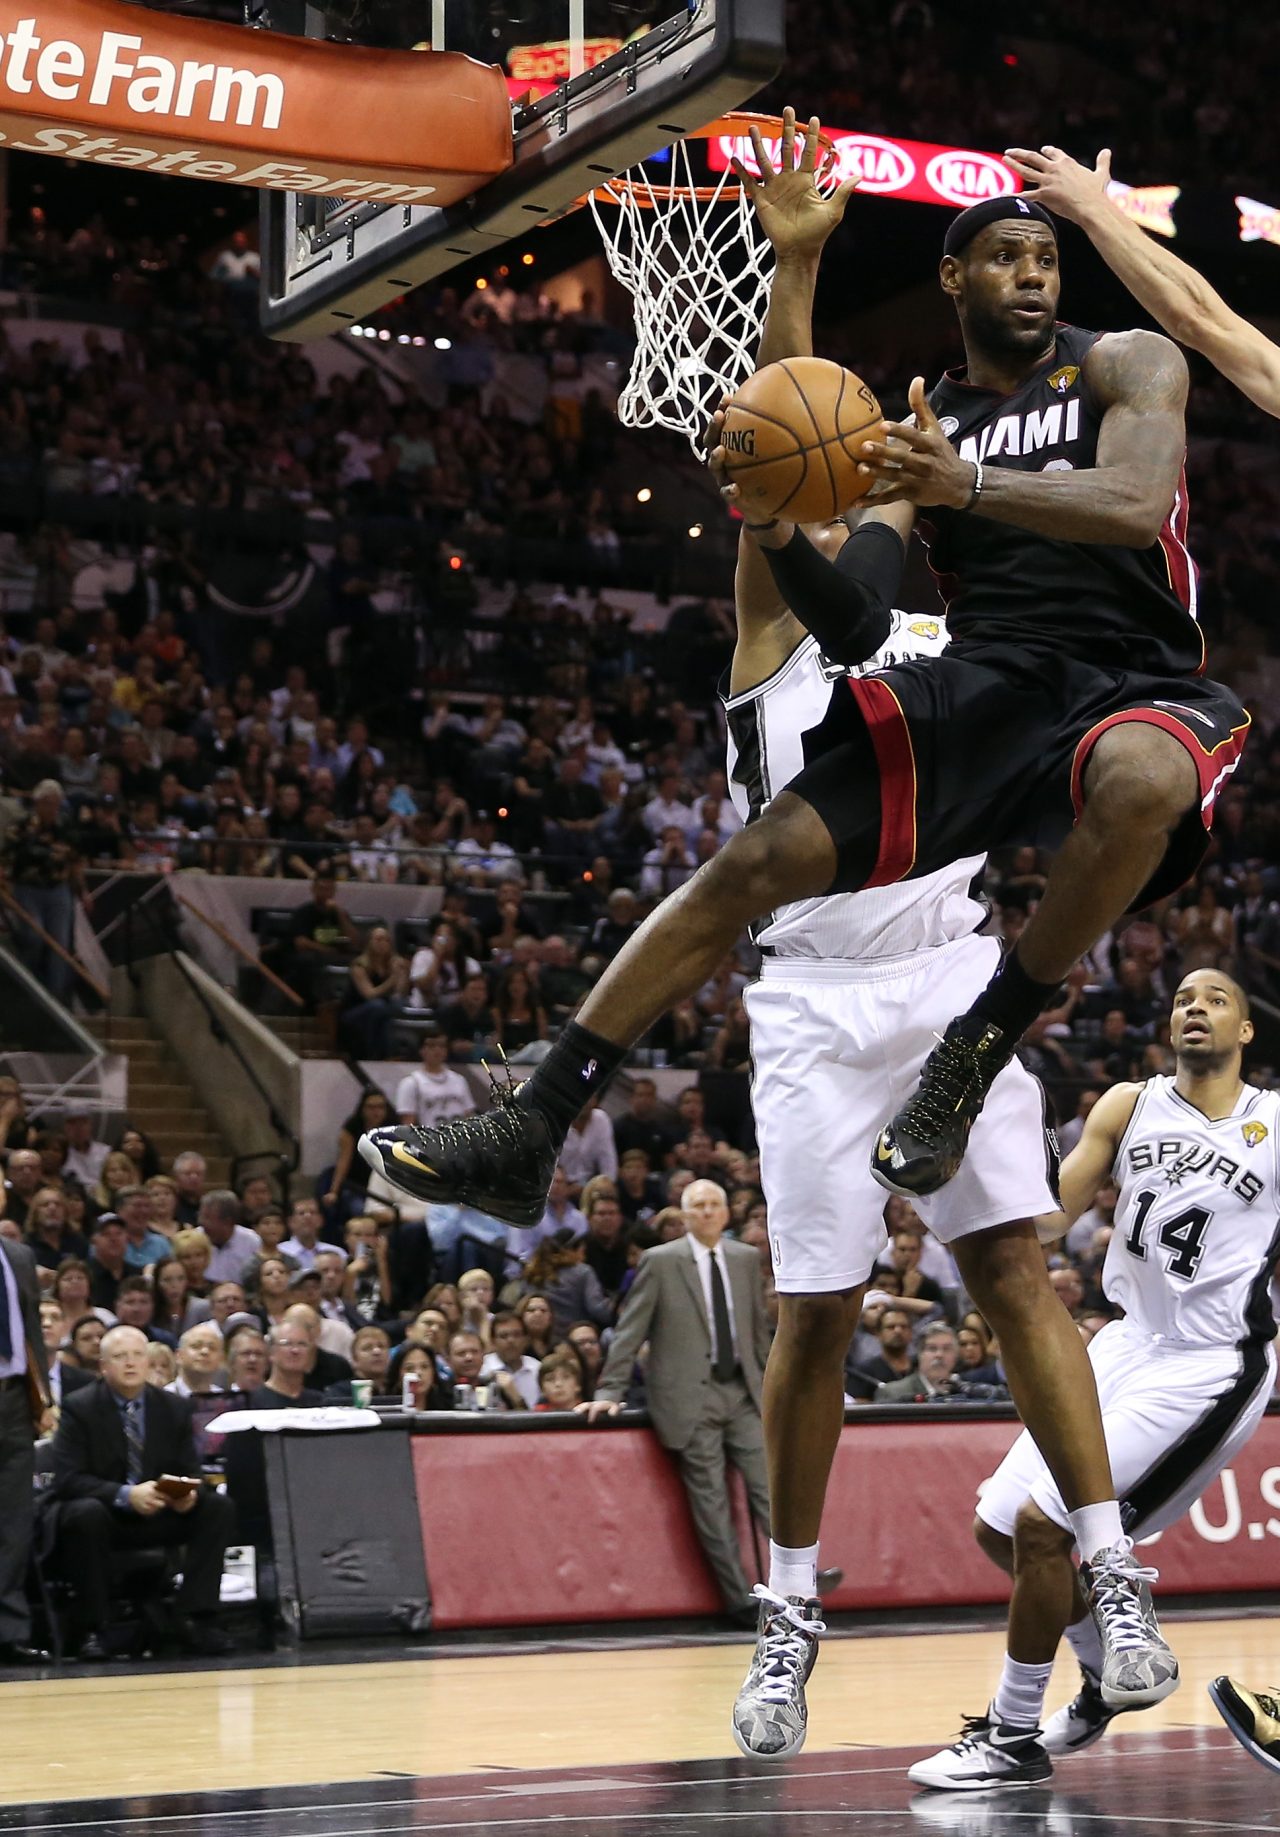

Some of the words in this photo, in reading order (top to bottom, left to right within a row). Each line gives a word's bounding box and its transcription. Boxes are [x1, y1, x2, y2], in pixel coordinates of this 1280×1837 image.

[936, 161, 1004, 195] KIA
[1128, 1140, 1266, 1206] SPURS
[1125, 1187, 1215, 1283] 14
